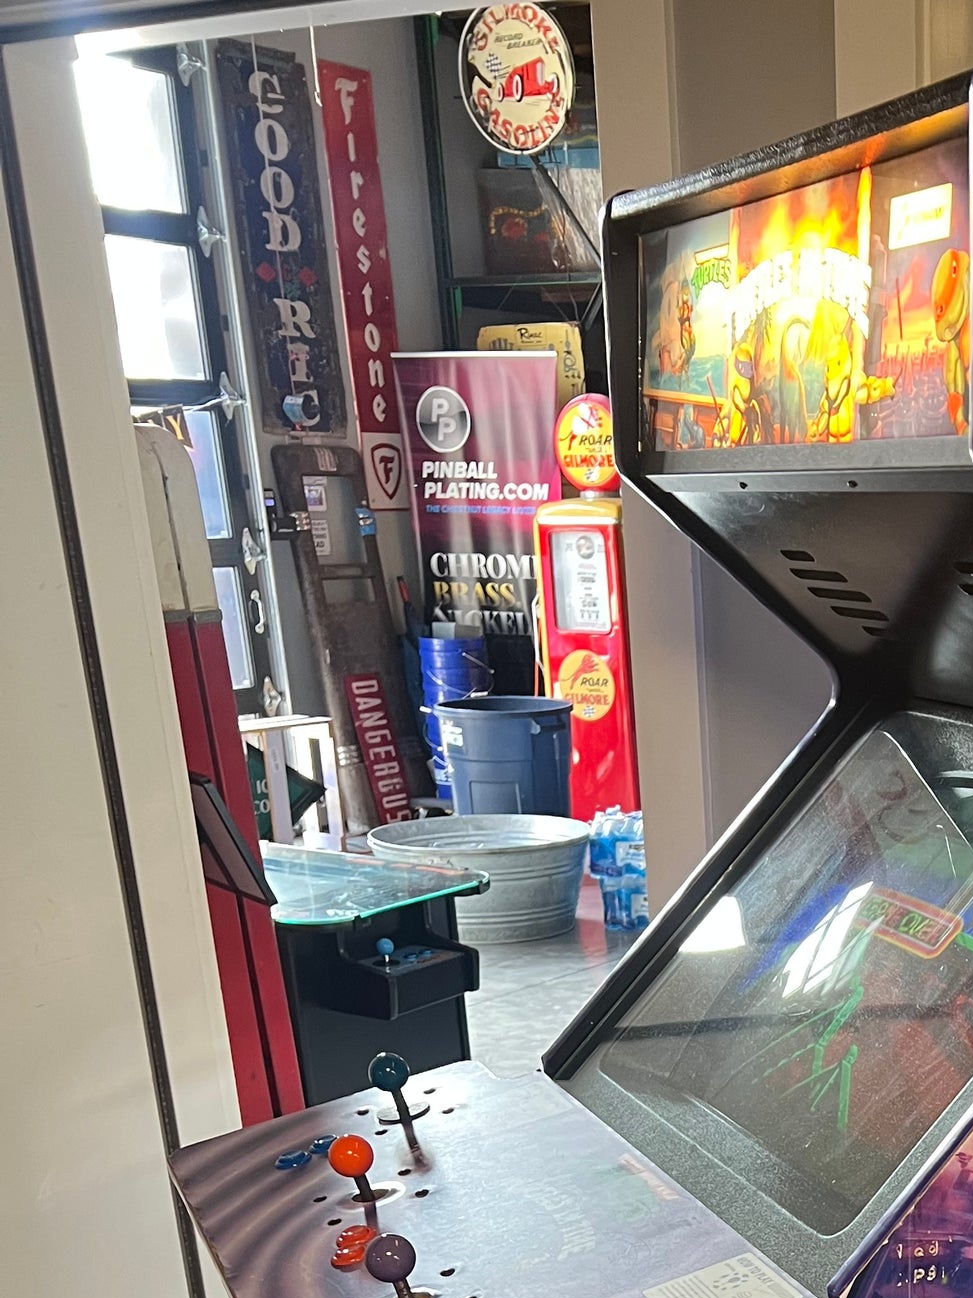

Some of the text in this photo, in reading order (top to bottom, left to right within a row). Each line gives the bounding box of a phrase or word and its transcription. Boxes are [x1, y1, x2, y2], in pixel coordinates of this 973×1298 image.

[475, 3, 559, 54] GILMORE
[494, 33, 523, 43] RECORD
[477, 88, 564, 147] GASOLINE
[334, 77, 387, 423] Firestone
[579, 434, 612, 446] ROAR
[422, 461, 498, 479] PINBALL
[424, 482, 549, 500] PLATING.COM
[581, 677, 609, 688] ROAR
